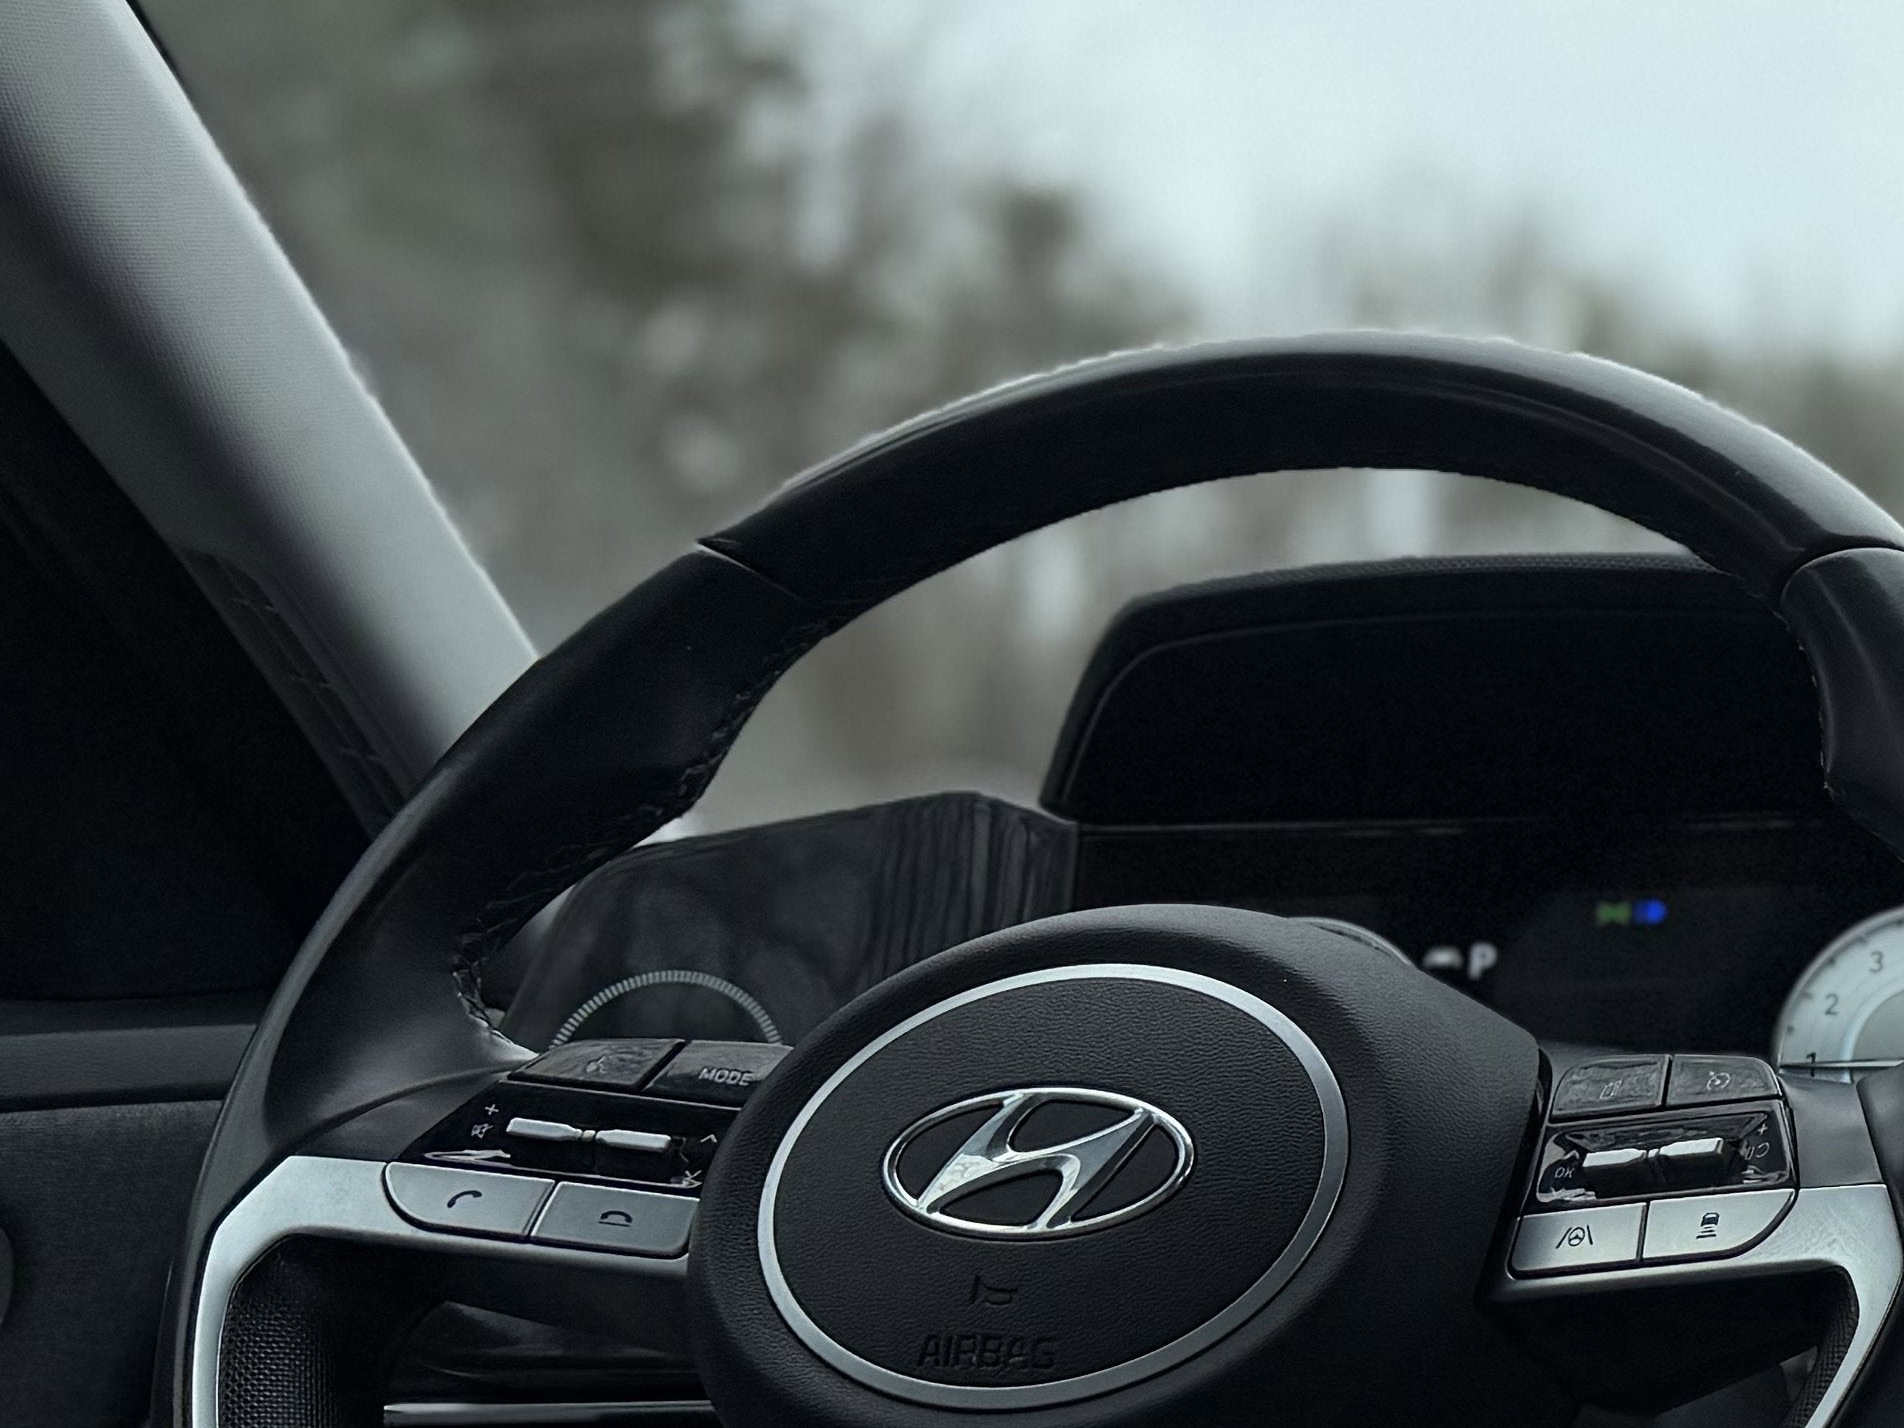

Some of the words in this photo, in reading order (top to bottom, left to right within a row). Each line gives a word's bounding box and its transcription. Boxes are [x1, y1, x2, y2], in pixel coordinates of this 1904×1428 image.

[1869, 951, 1884, 973] 3
[1824, 993, 1840, 1015] 2
[698, 1067, 753, 1087] MODE
[918, 1332, 1058, 1371] AIRBAG
